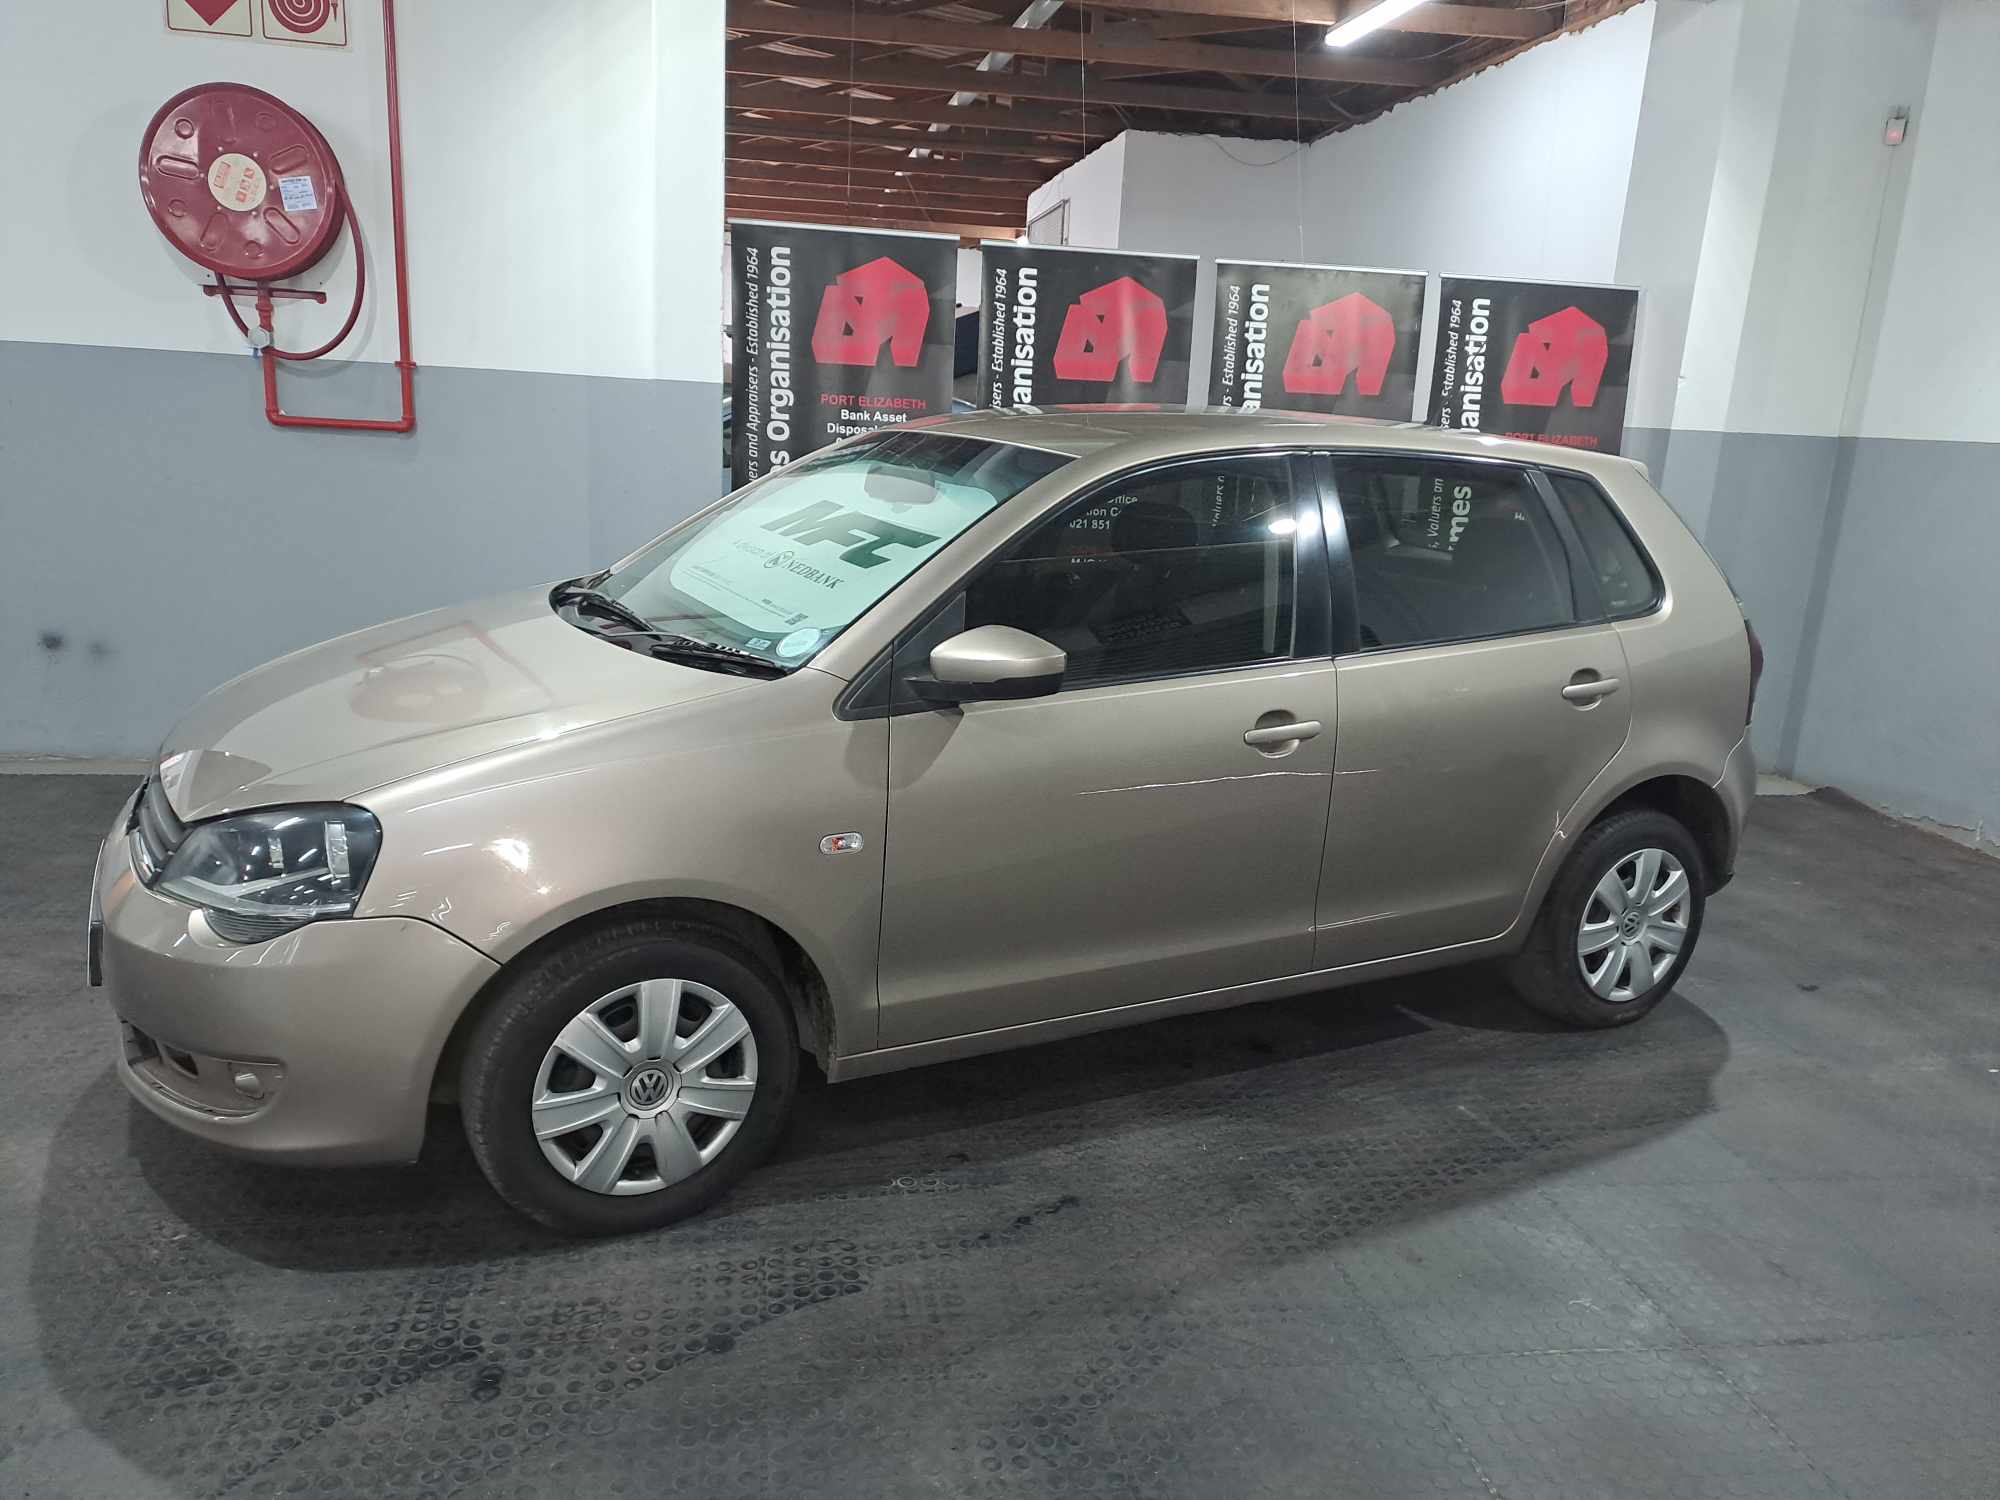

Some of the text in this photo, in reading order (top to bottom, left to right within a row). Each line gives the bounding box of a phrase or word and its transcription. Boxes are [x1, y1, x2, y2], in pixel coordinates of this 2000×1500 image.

[746, 247, 759, 279] 1964
[994, 268, 1008, 300] 1964
[1228, 285, 1241, 315] 1964
[746, 282, 759, 355] Established
[1449, 300, 1462, 328] 1964
[766, 246, 794, 442] Organisation
[991, 303, 1006, 372] Established
[1222, 318, 1238, 386] Established
[746, 365, 760, 431] Appraisers
[820, 393, 926, 409] PORT ELIZABETH
[840, 408, 907, 423] Bank Asset
[746, 433, 759, 457] and
[1091, 519, 1111, 530] 851
[1427, 496, 1441, 536] Valuers
[783, 560, 844, 589] NEDBANK
